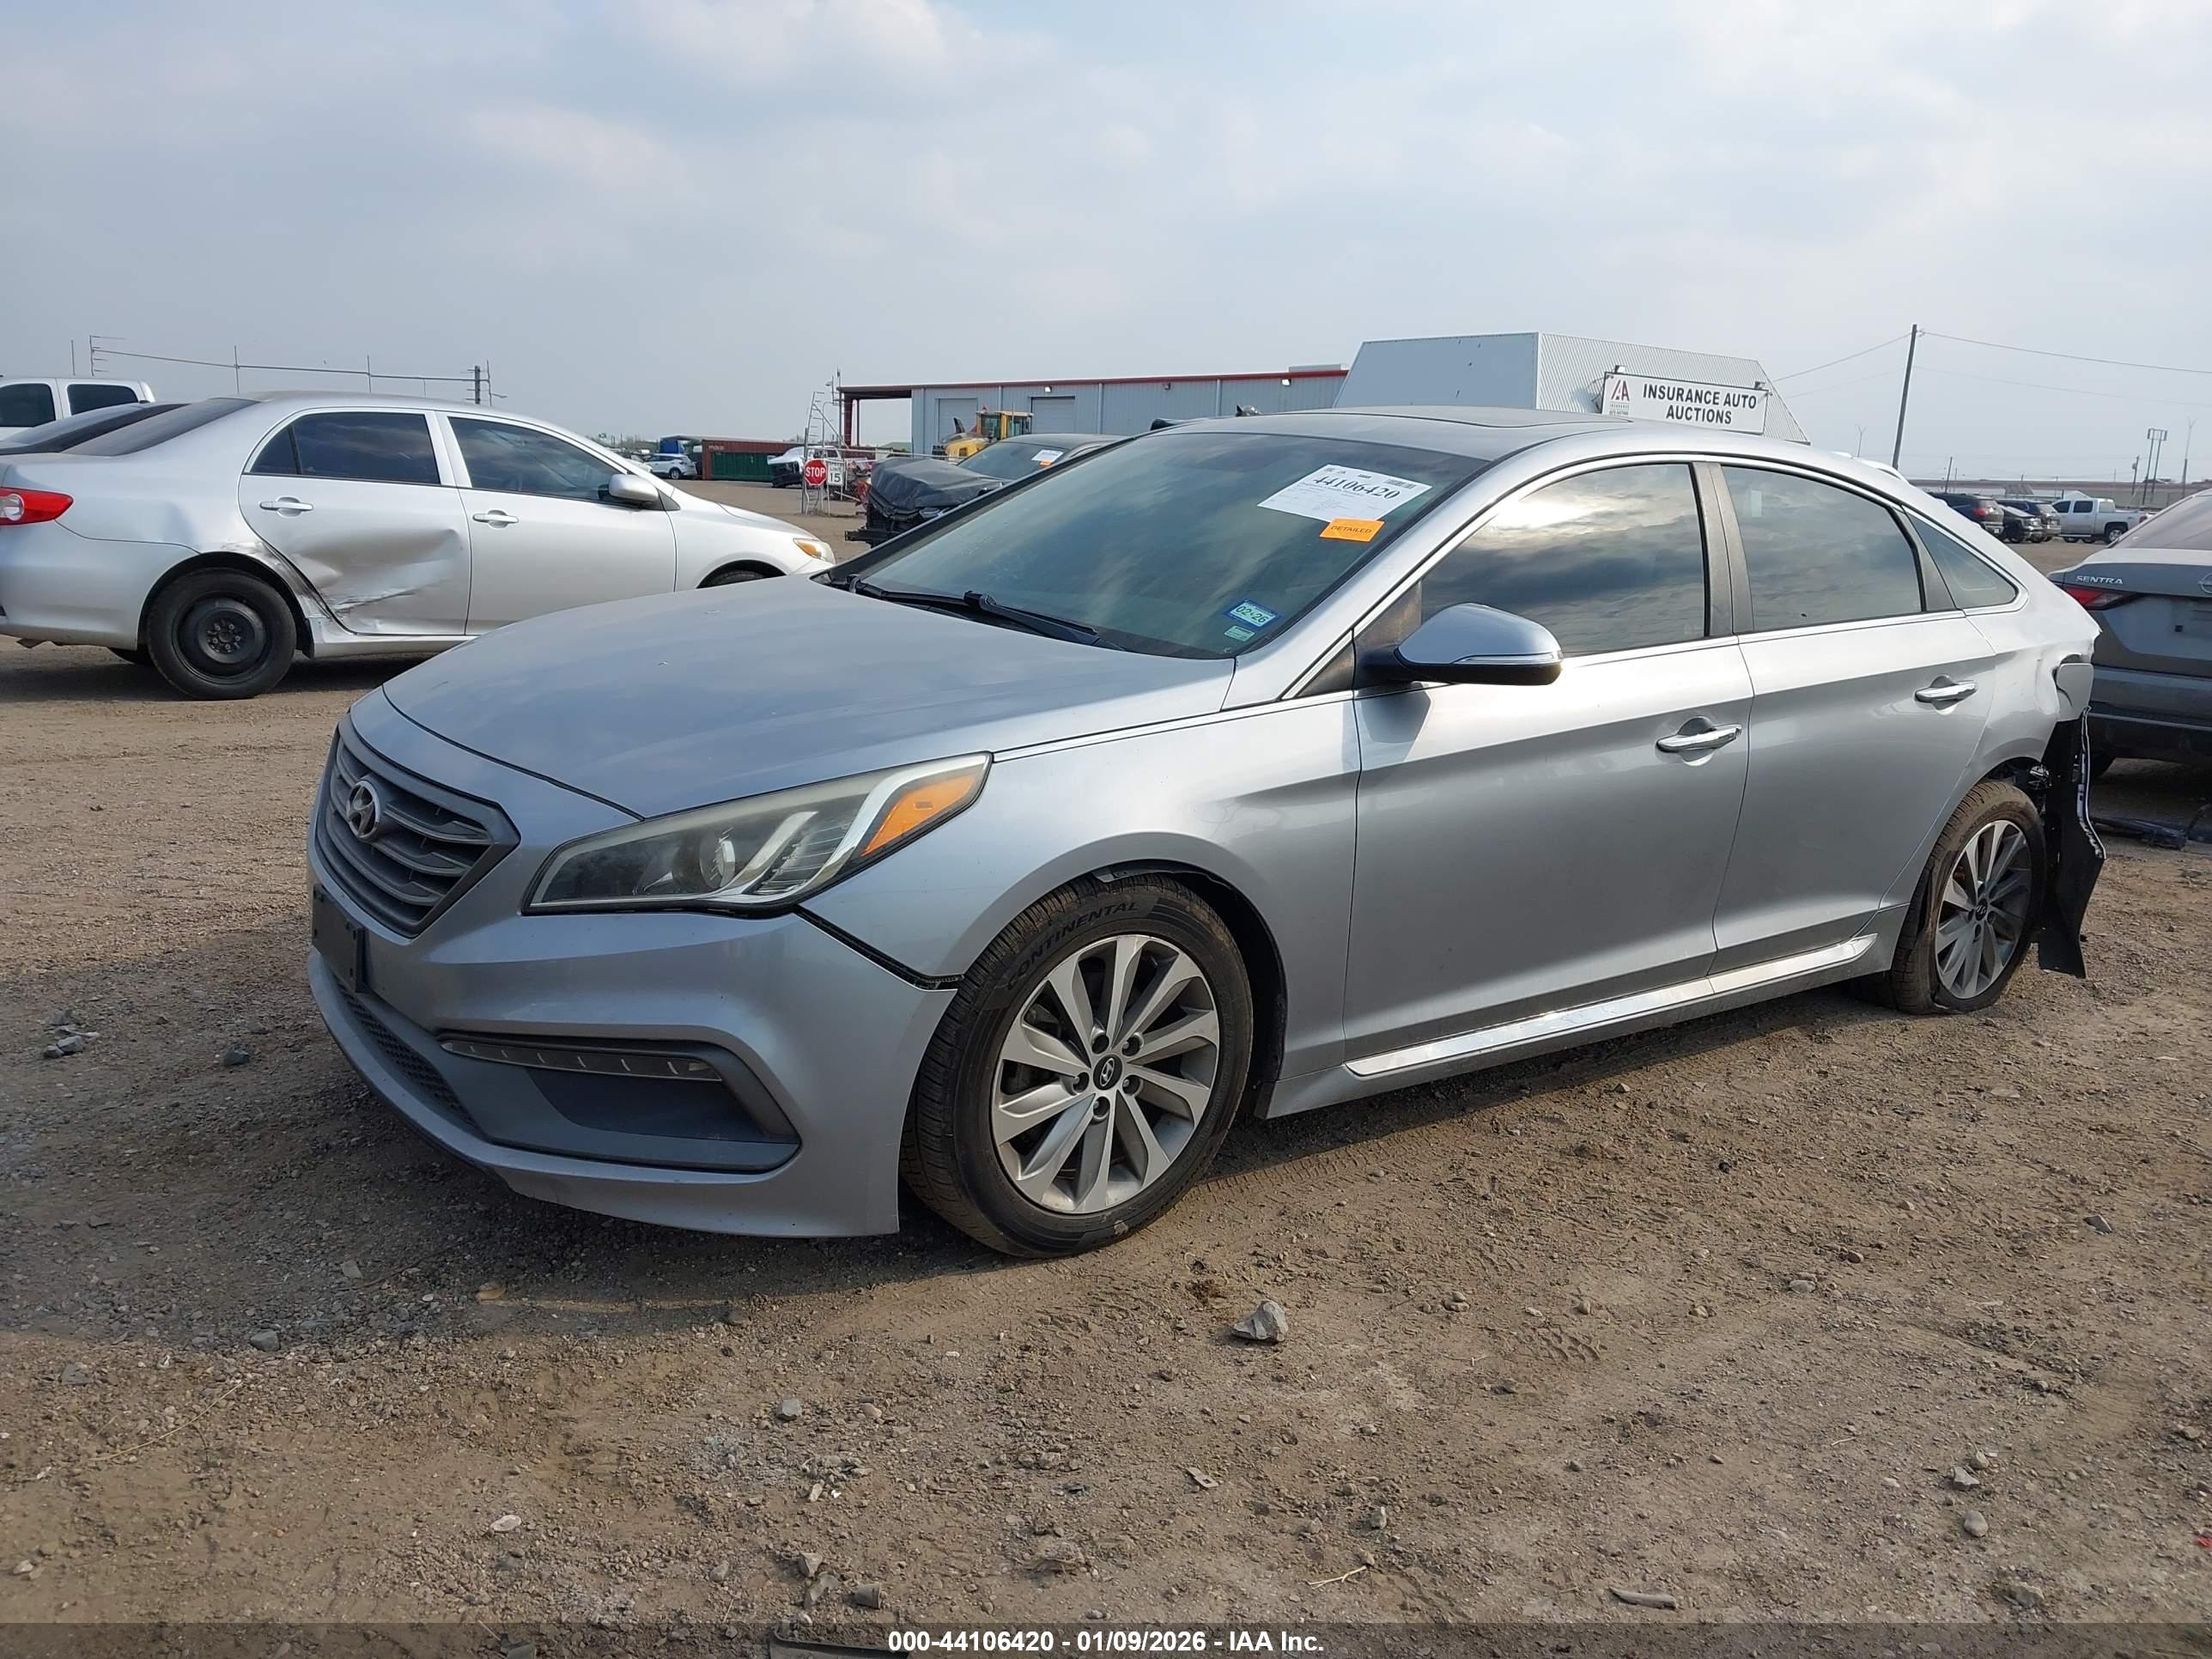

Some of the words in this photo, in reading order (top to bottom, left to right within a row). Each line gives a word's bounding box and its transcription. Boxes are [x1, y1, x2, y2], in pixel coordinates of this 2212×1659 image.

[1643, 383, 1720, 405] INSURANCE
[1723, 392, 1757, 409] AUTO
[1666, 404, 1732, 424] AUCTIONS
[805, 466, 826, 477] STOP
[830, 473, 841, 483] 15
[1313, 475, 1401, 500] 44106420
[1330, 525, 1372, 534] DETAILED
[2075, 575, 2124, 585] SENTRA
[1007, 902, 1139, 990] CONTINENTAL
